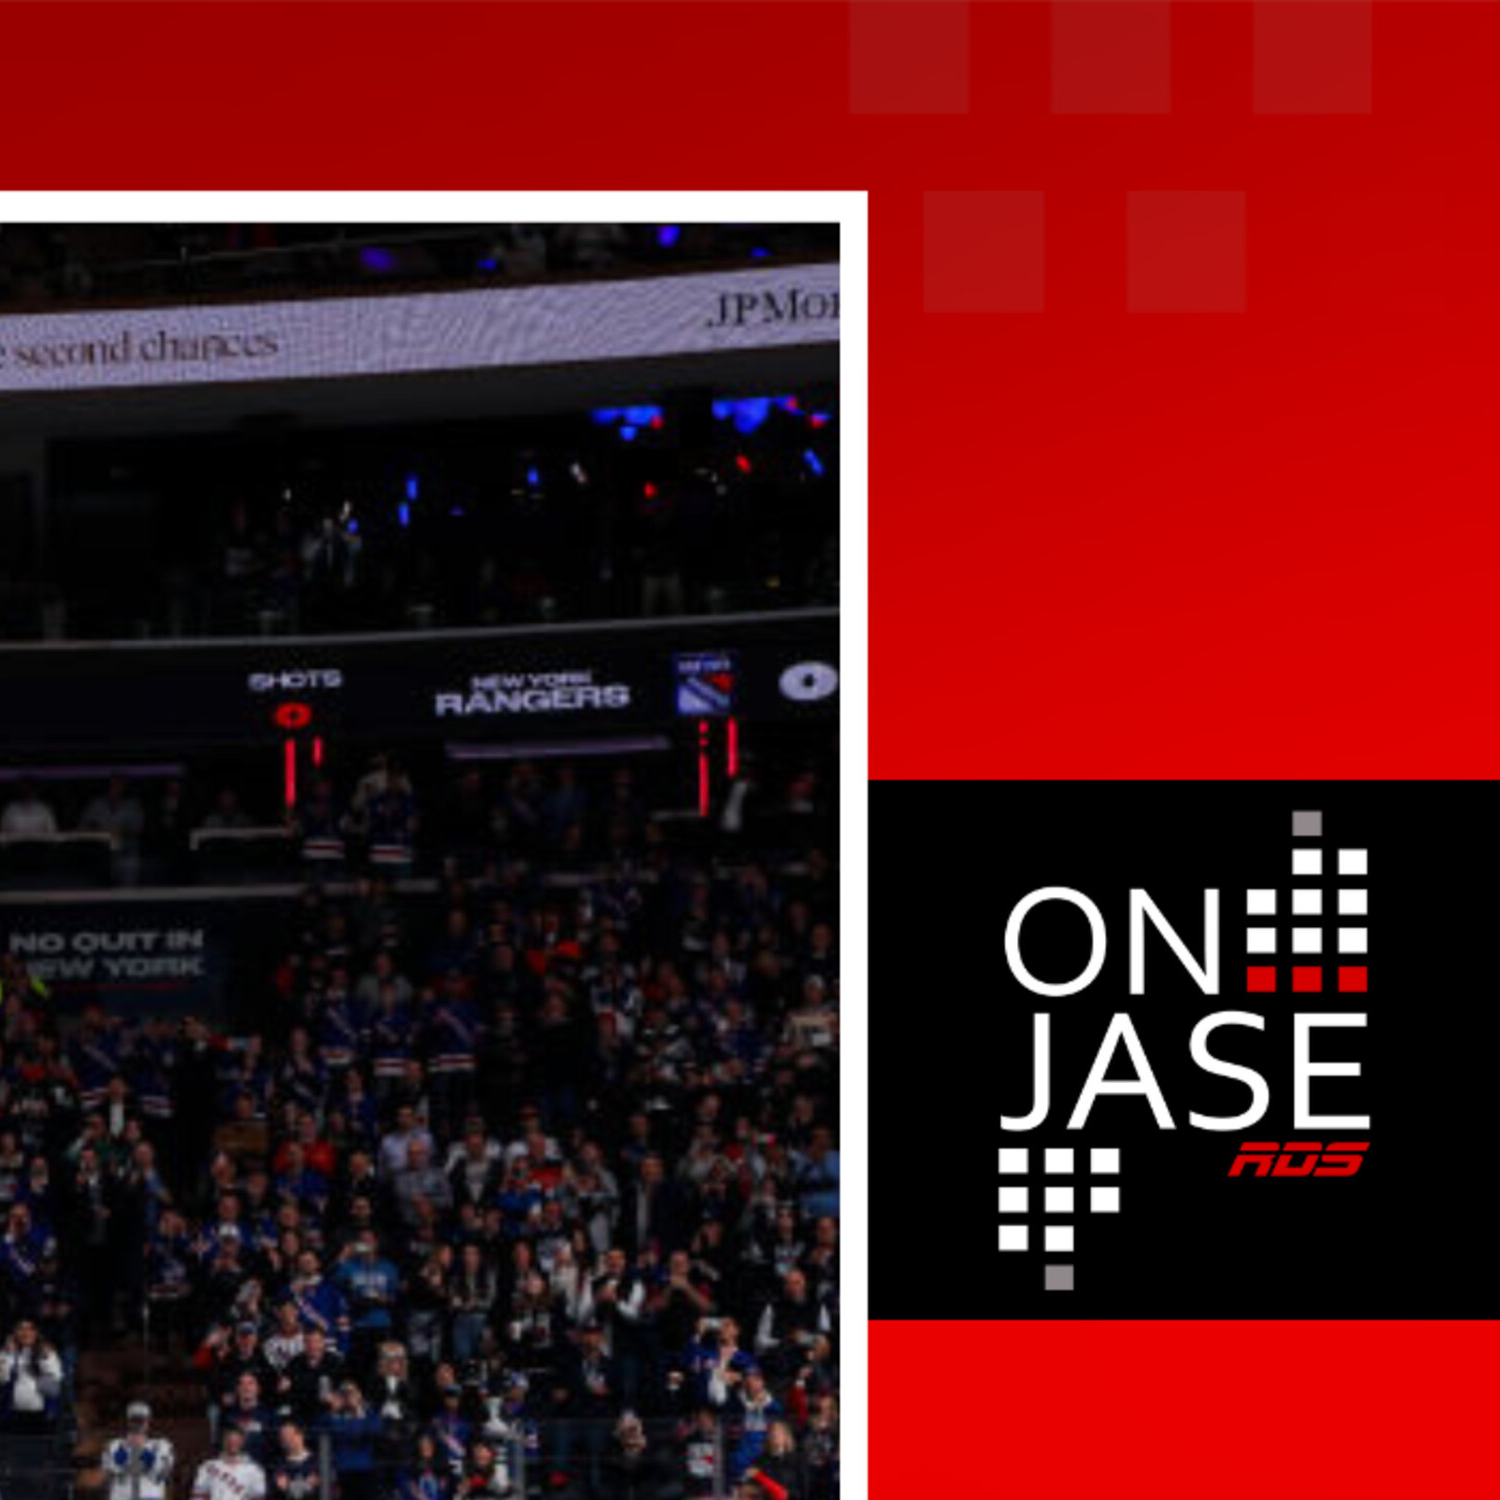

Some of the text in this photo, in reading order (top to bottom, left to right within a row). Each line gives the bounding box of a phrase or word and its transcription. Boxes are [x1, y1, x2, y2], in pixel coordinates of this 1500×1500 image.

[14, 333, 130, 369] second
[138, 330, 279, 364] chances
[434, 684, 630, 716] RANGERS
[8, 929, 204, 953] NO QUIT IN
[102, 956, 205, 977] YORK
